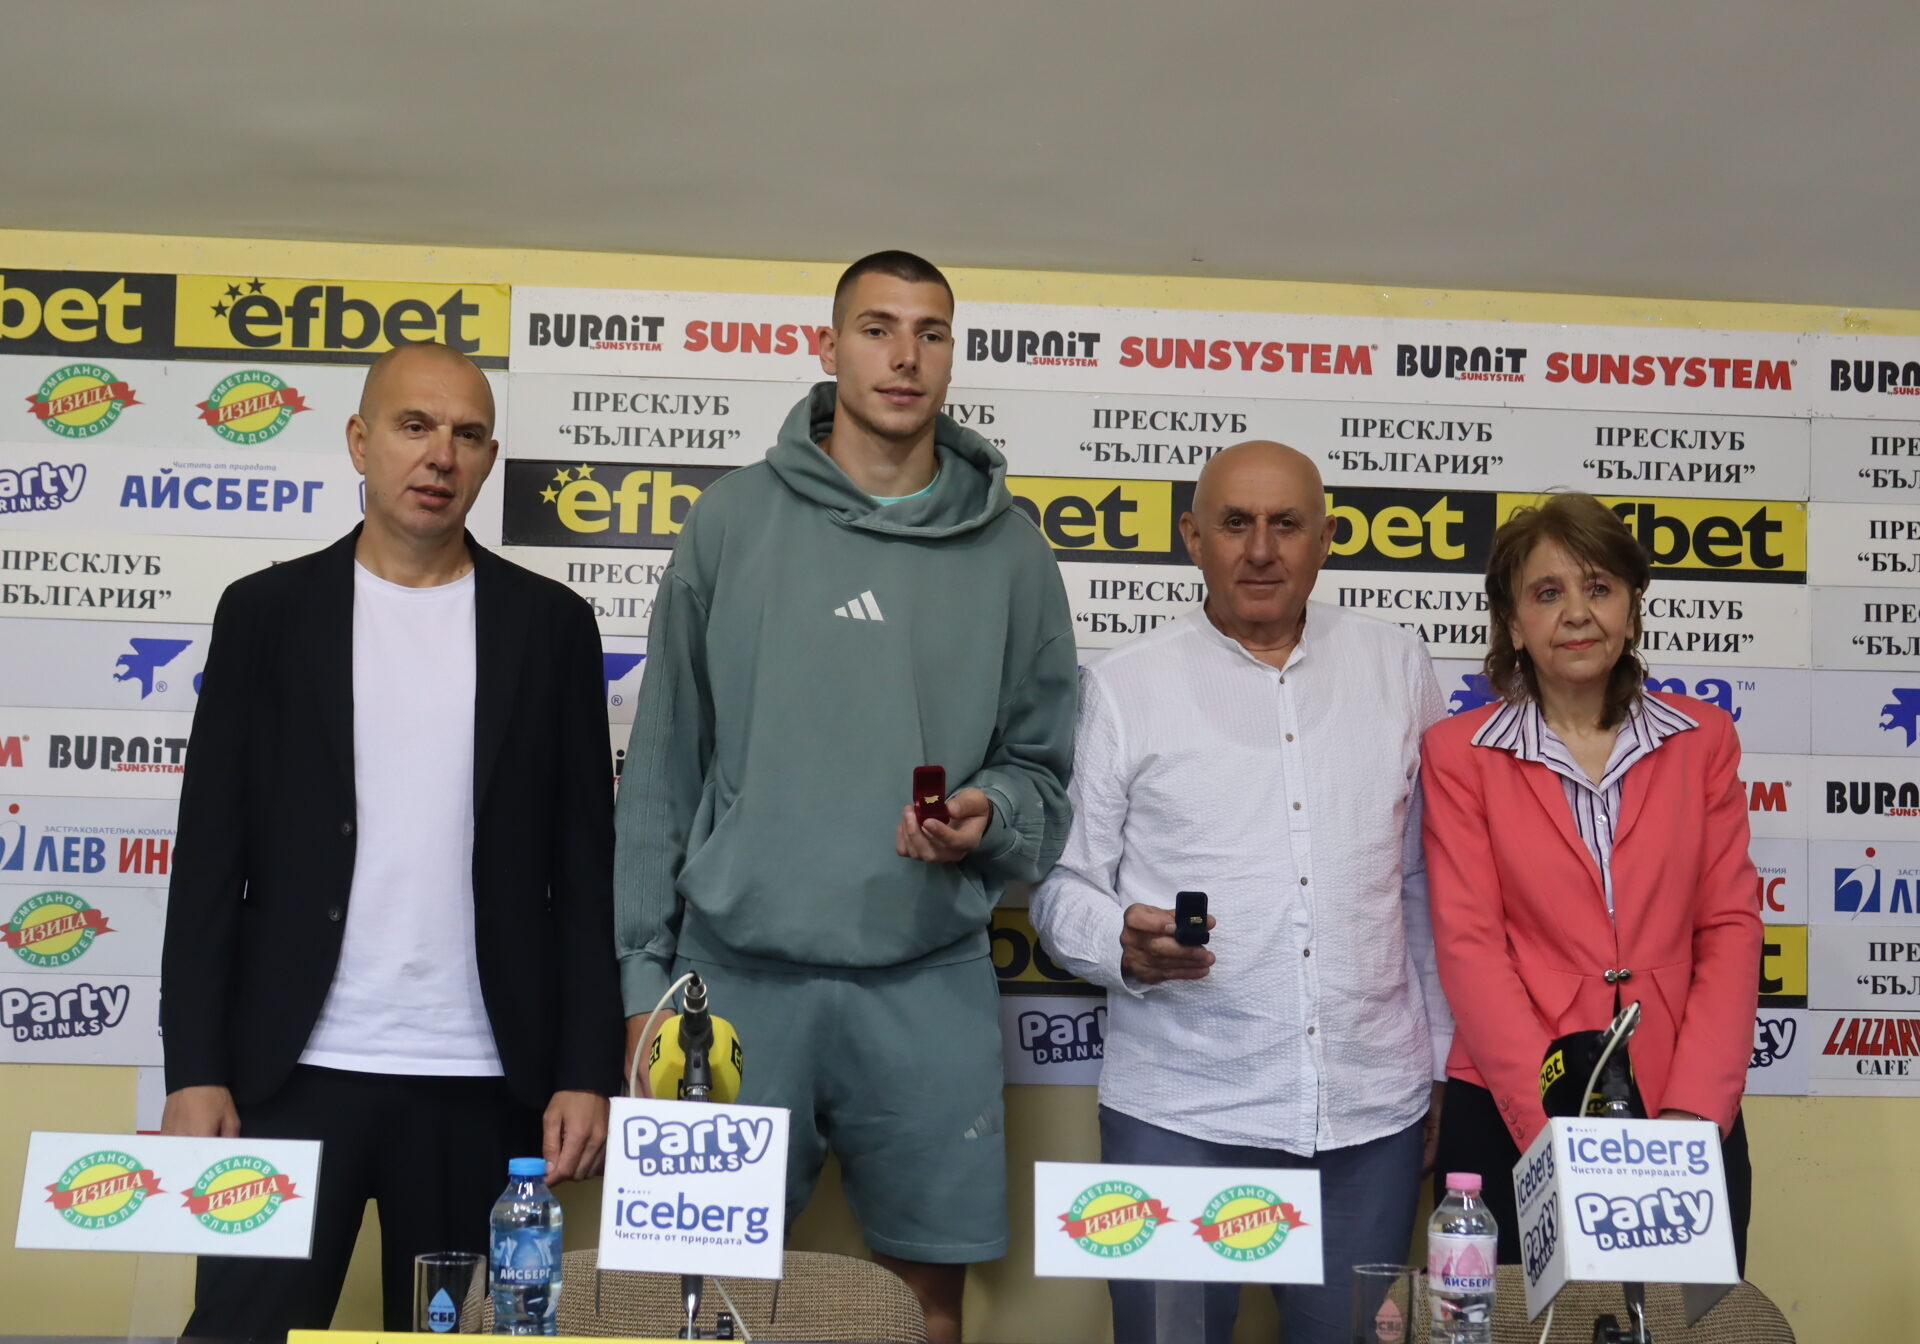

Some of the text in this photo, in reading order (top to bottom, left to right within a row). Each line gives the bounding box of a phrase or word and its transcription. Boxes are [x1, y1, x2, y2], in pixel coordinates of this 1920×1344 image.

[228, 285, 480, 353] efbet
[596, 341, 662, 351] SUNSYSTEM
[1119, 336, 1372, 375] SUNSYSTEM
[1032, 357, 1098, 367] SUNSYSTEM
[1460, 372, 1525, 382] SUNSYSTEM
[1545, 352, 1792, 390] SUNSYSTEM
[41, 366, 111, 396] СМЕТАНОВ
[211, 373, 280, 402] СМЕТАНОВ
[48, 384, 115, 416] ИЗИДА
[219, 390, 284, 422] ИЗИДА
[572, 391, 730, 416] ПРЕСКЛУБ
[1092, 409, 1247, 433] ПРЕСКЛУБ
[1340, 418, 1492, 442] ПРЕСКЛУБ
[1595, 426, 1745, 451] ПРЕСКЛУБ
[119, 468, 324, 513] АЙСБЕРГ
[1, 550, 161, 575] ПРЕСКЛУБ
[1864, 603, 1920, 623] ПРЕ
[117, 764, 185, 773] SUNSYSTEM
[34, 836, 174, 874] ЛЕВ ИН
[13, 894, 83, 925] СМЕТАНОВ
[20, 912, 88, 945] ИЗИДА
[1, 983, 130, 1027] Party
[15, 1019, 102, 1040] DRINKS
[625, 1115, 772, 1162] Party
[1566, 1126, 1709, 1175] iceberg
[641, 1153, 740, 1175] DRINKS
[1571, 1166, 1687, 1178] Чистота от природата
[72, 1172, 143, 1206] ИЗИДА
[208, 1177, 279, 1211] ИЗИДА
[615, 1187, 769, 1244] iceberg
[1085, 1202, 1153, 1235] ИЗИДА
[1218, 1205, 1286, 1239] ИЗИДА
[1576, 1188, 1713, 1235] Party
[615, 1230, 742, 1246] Чистота от природата
[1599, 1226, 1691, 1250] DRINKS
